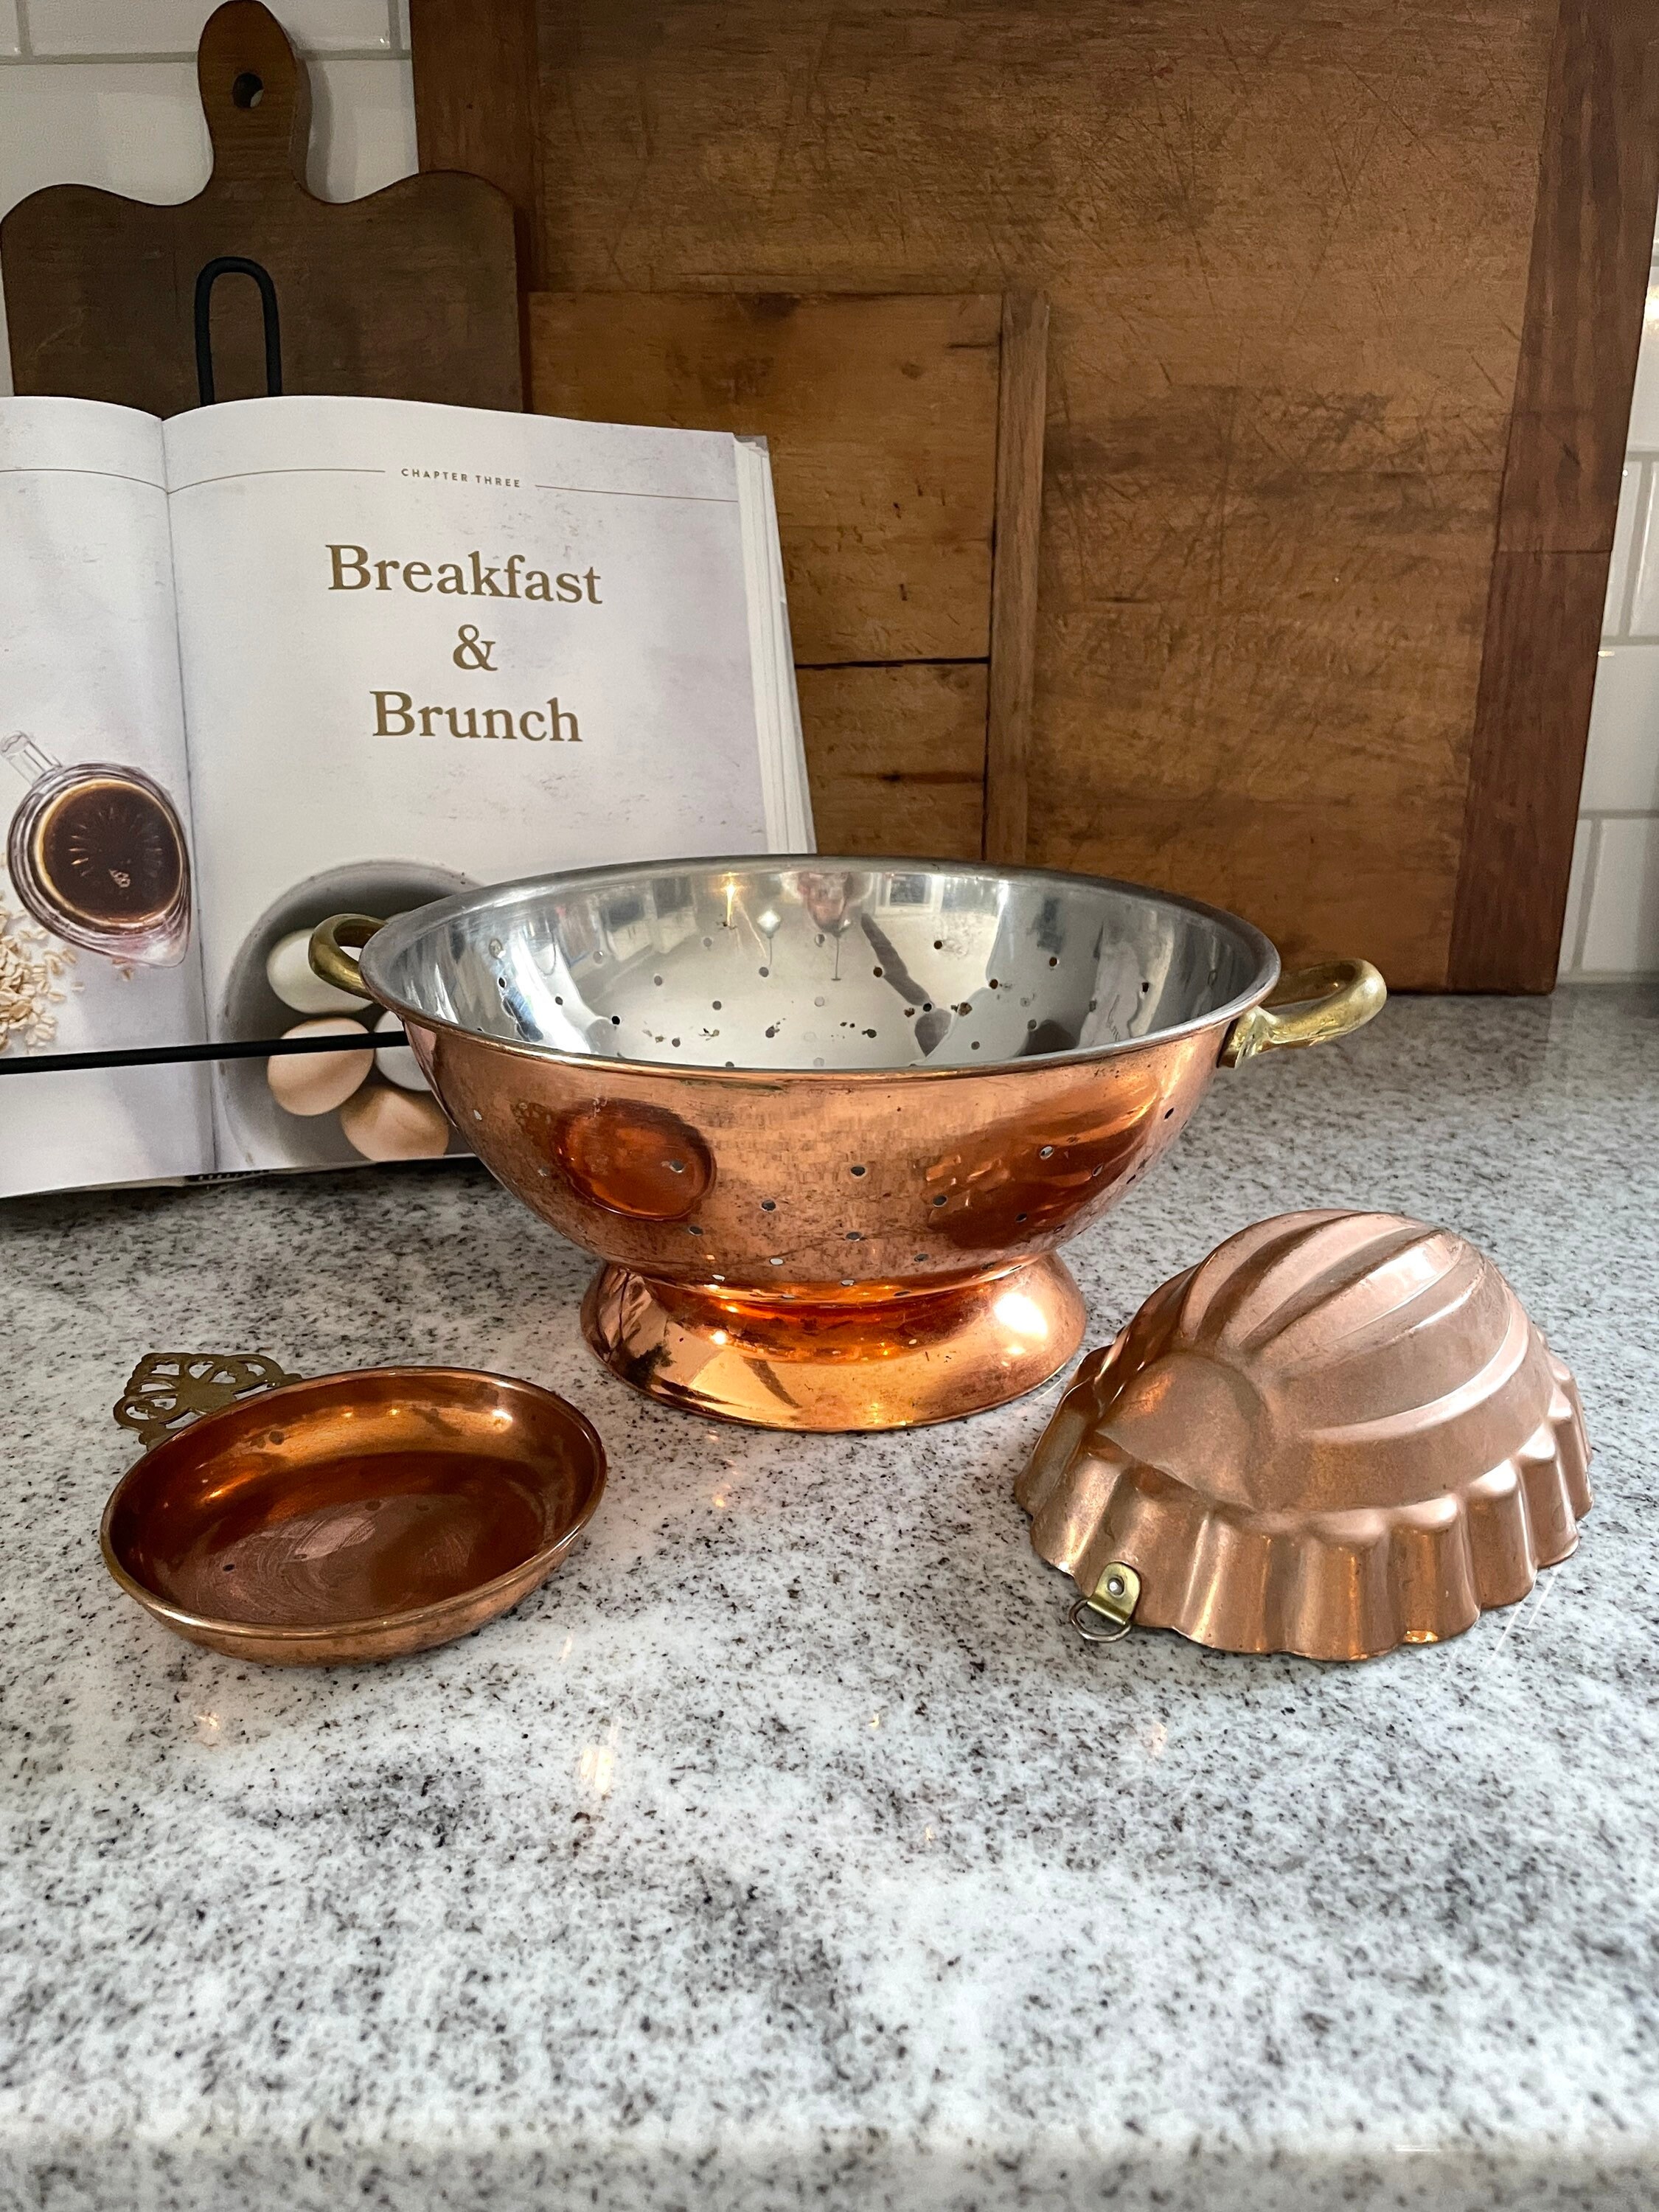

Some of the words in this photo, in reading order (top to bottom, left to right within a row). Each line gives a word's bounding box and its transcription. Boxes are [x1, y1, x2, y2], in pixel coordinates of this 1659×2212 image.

[400, 467, 468, 482] CHAPTER
[475, 475, 521, 488] THREE
[324, 544, 603, 605] Breakfast
[452, 624, 498, 672] &
[369, 690, 583, 742] Brunch
